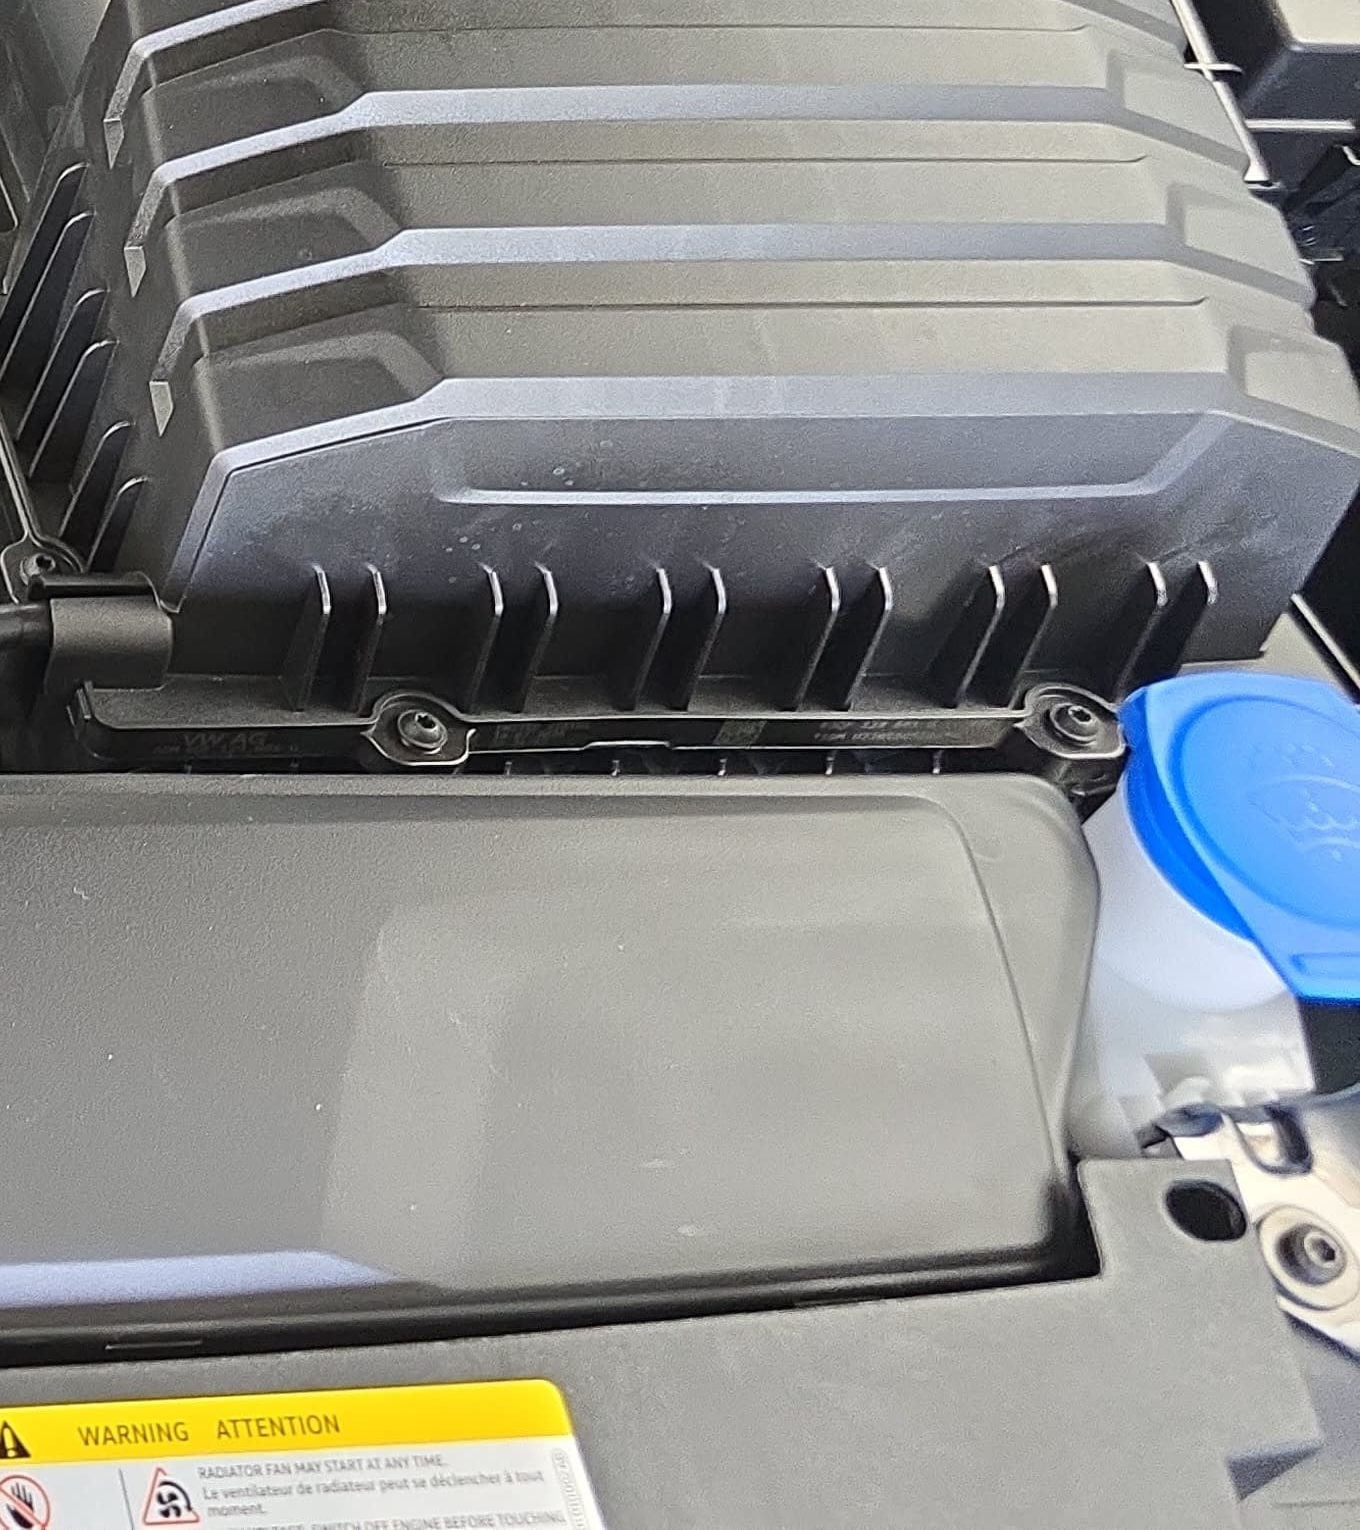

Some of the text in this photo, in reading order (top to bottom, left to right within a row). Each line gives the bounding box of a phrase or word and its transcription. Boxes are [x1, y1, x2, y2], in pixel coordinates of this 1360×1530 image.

[78, 1414, 341, 1447] WARNING ATTENTION
[197, 1453, 449, 1479] RADIATOR FAN MAY START AT ANY TIME.
[203, 1486, 218, 1500] Le
[224, 1483, 293, 1499] ventilateur
[296, 1481, 313, 1496] de
[317, 1478, 376, 1494] radiateur
[380, 1476, 410, 1493] peut
[412, 1477, 427, 1488] se
[429, 1472, 501, 1487] déclencher
[516, 1470, 545, 1483] tout
[207, 1503, 267, 1517] moment.
